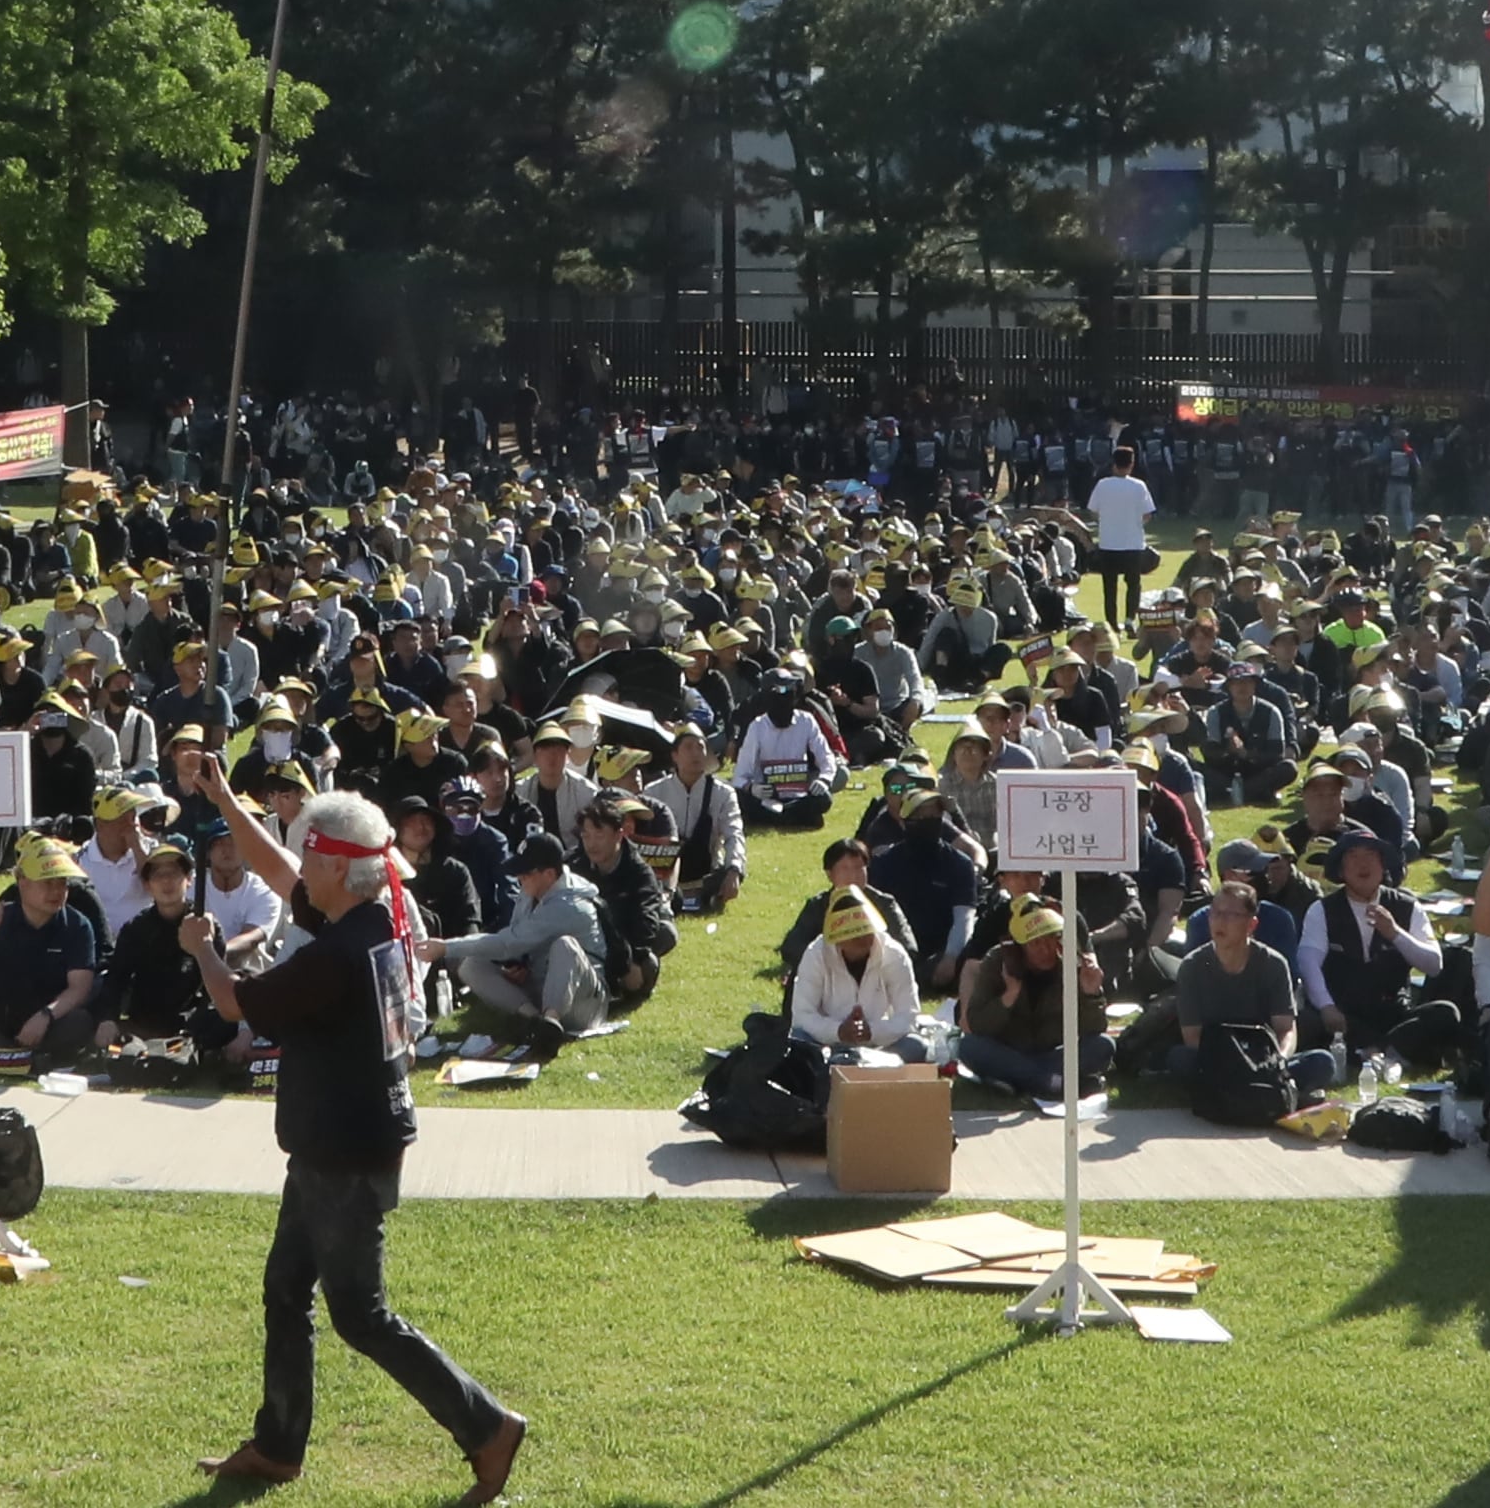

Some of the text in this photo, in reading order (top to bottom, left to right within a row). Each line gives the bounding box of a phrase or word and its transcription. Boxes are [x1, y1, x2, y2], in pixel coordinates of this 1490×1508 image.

[1193, 396, 1238, 415] 상여금
[1041, 791, 1093, 812] 1공장
[1035, 833, 1099, 855] 사업부
